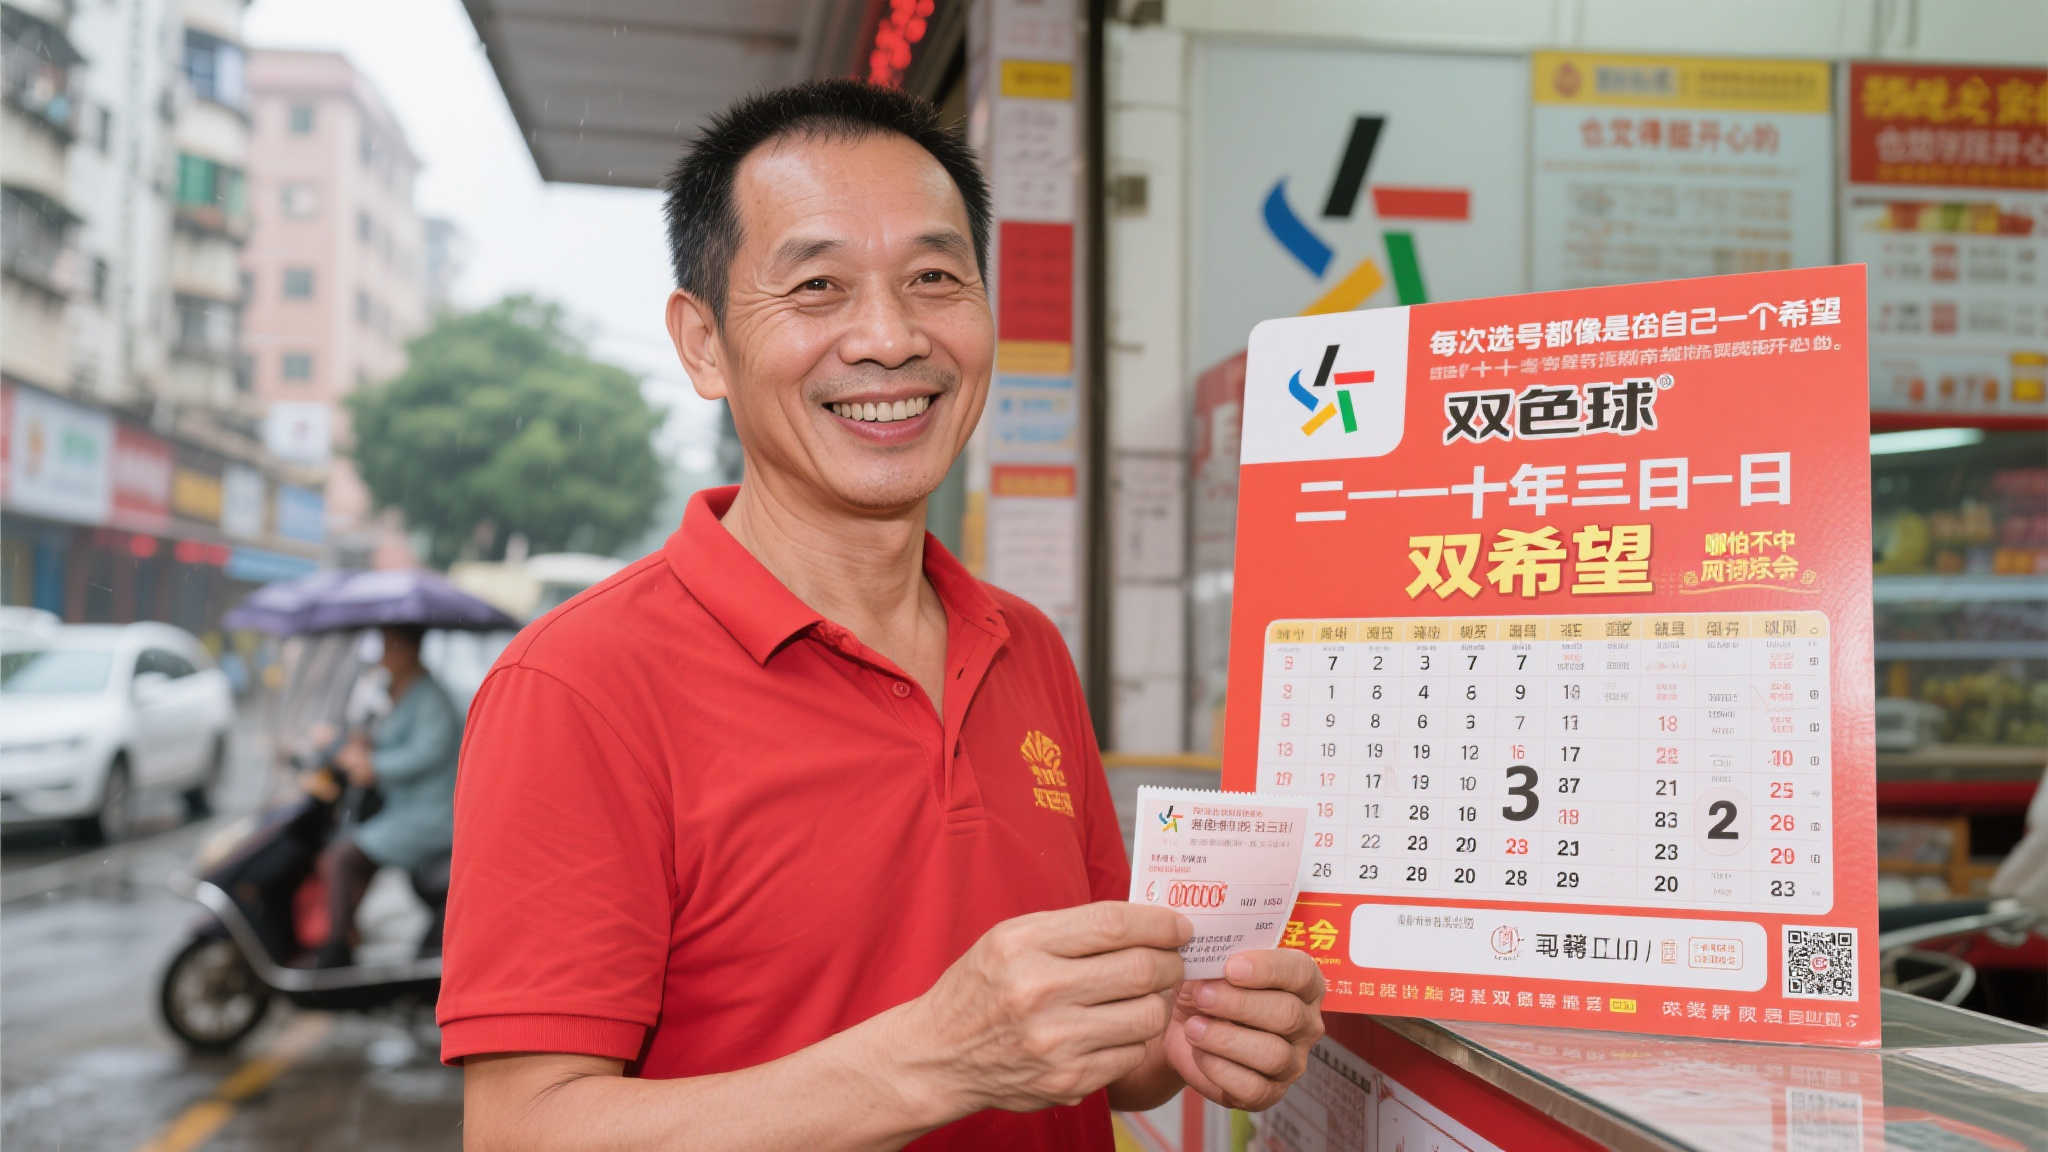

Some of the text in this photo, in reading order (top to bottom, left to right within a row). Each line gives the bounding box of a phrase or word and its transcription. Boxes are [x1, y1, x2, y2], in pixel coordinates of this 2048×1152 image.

[1443, 380, 1657, 445] 双色球
[1404, 524, 1654, 598] 双希望
[1327, 655, 1338, 671] 7
[1372, 655, 1383, 671] 2
[1419, 655, 1430, 671] 3
[1467, 655, 1478, 671] 7
[1516, 654, 1527, 671] 7
[1329, 684, 1335, 700] 1
[1418, 684, 1430, 700] 4
[1515, 684, 1526, 701] 9
[1514, 715, 1526, 731] 7
[1560, 745, 1581, 763] 17
[1502, 765, 1540, 822] 3
[1655, 779, 1677, 797] 21
[1408, 804, 1430, 821] 26
[1707, 800, 1739, 840] 2
[1453, 867, 1476, 884] 20
[1504, 869, 1528, 887] 28
[1653, 875, 1679, 893] 20
